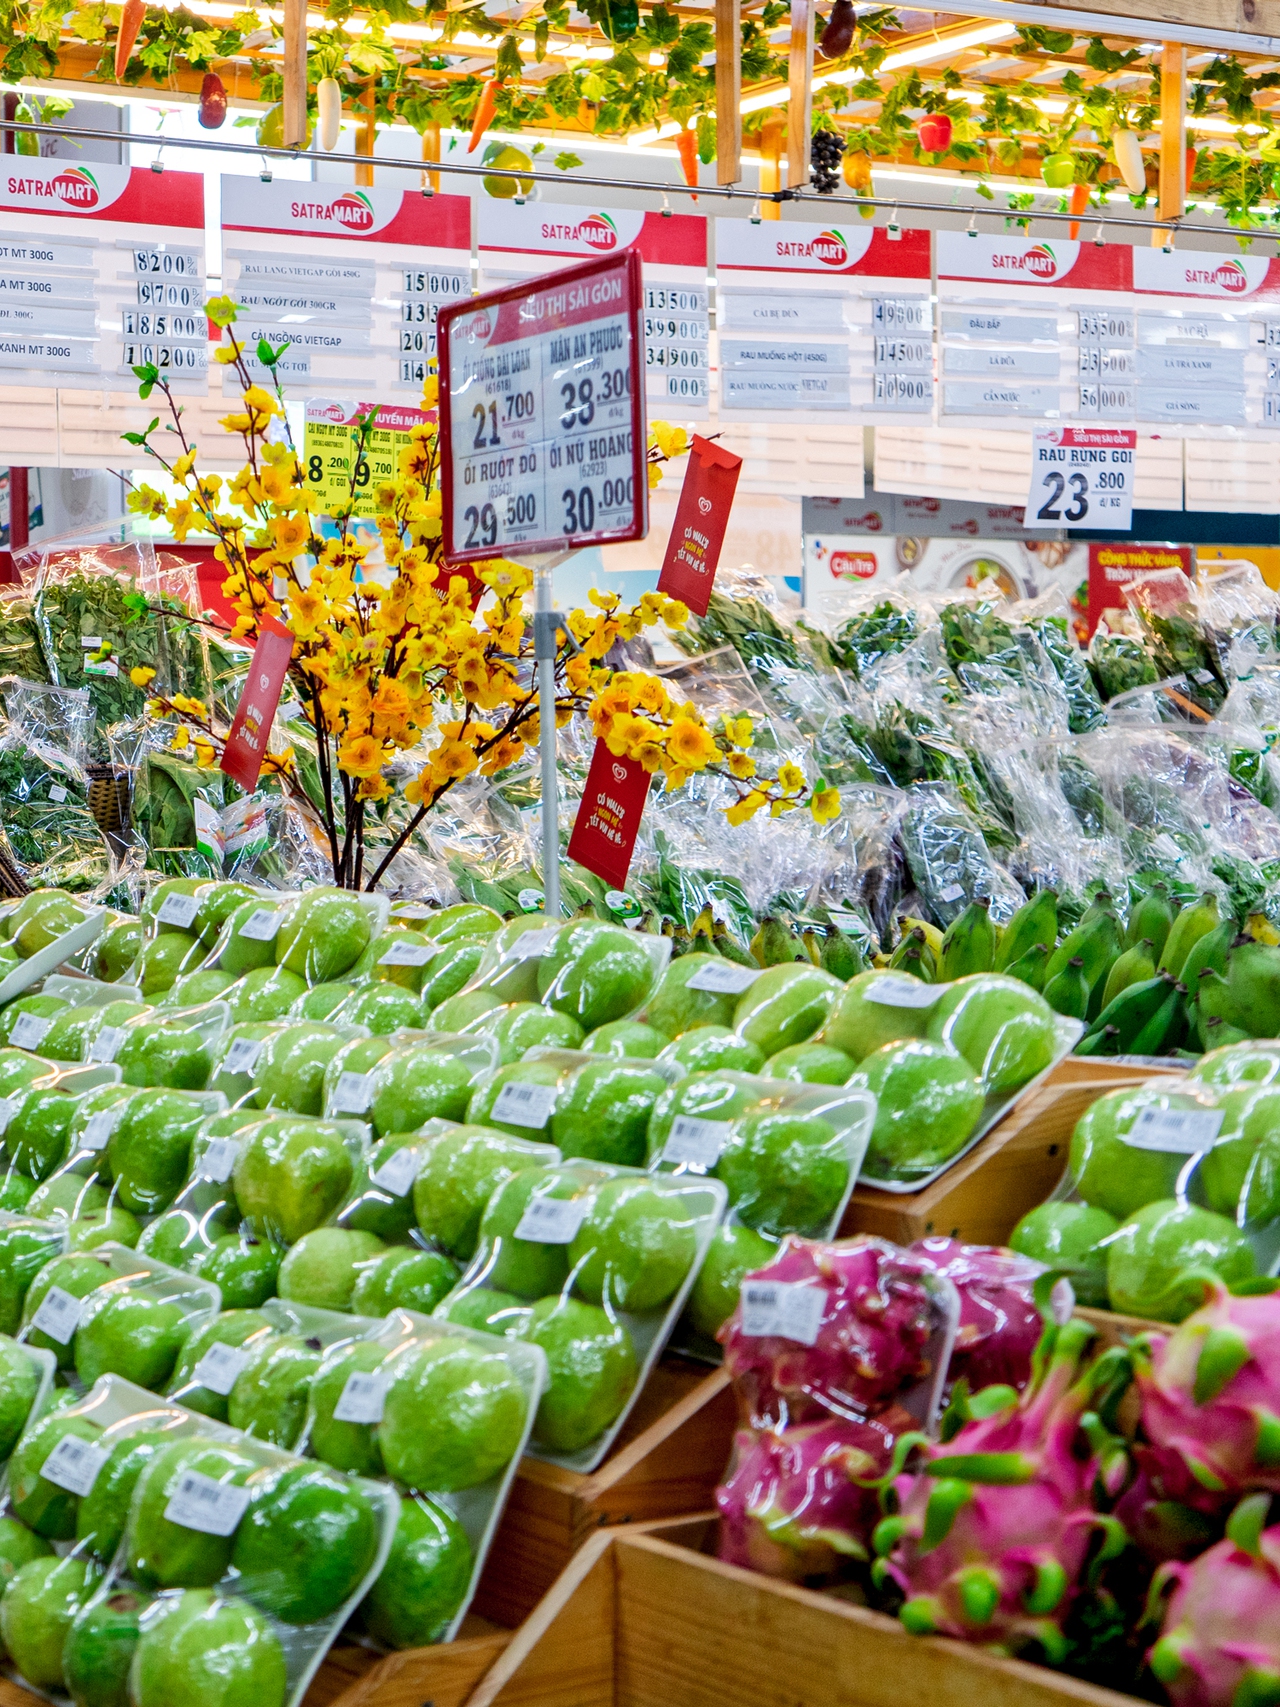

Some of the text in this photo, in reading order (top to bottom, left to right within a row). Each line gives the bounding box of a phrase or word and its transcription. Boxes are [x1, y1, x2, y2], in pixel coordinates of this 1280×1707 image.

[8, 177, 93, 200] SATRAMART
[291, 202, 370, 224] SATRAMART
[542, 224, 613, 243] SATRAMART
[10, 248, 27, 259] MT
[30, 250, 54, 261] 300G
[776, 241, 843, 260] SATRAMART
[138, 252, 185, 273] 8200
[245, 264, 262, 274] RAU
[264, 265, 287, 276] LANG
[288, 267, 324, 277] VIETGAP
[992, 255, 1053, 273] SATRAMART
[9, 280, 25, 291] MT
[27, 281, 52, 293] 300G
[1186, 269, 1243, 288] SATRAMART
[141, 284, 190, 306] 9700
[240, 295, 258, 306] RAU
[309, 299, 336, 311] 300GR
[569, 286, 589, 311] SÀI
[591, 278, 621, 306] GÒN
[125, 314, 195, 336] 18500
[28, 344, 44, 355] MT
[46, 345, 71, 357] 300G
[305, 335, 342, 348] VIETGAP
[574, 333, 586, 359] AN
[740, 350, 755, 360] RAU
[560, 378, 595, 430] 38
[472, 391, 535, 449] 21 .700
[1039, 448, 1066, 461] RAU
[308, 455, 323, 482] 8
[354, 461, 392, 487] 9 .700
[1037, 471, 1088, 521] 23
[1095, 472, 1125, 489] .800
[562, 486, 595, 535] 30
[464, 502, 498, 549] 29
